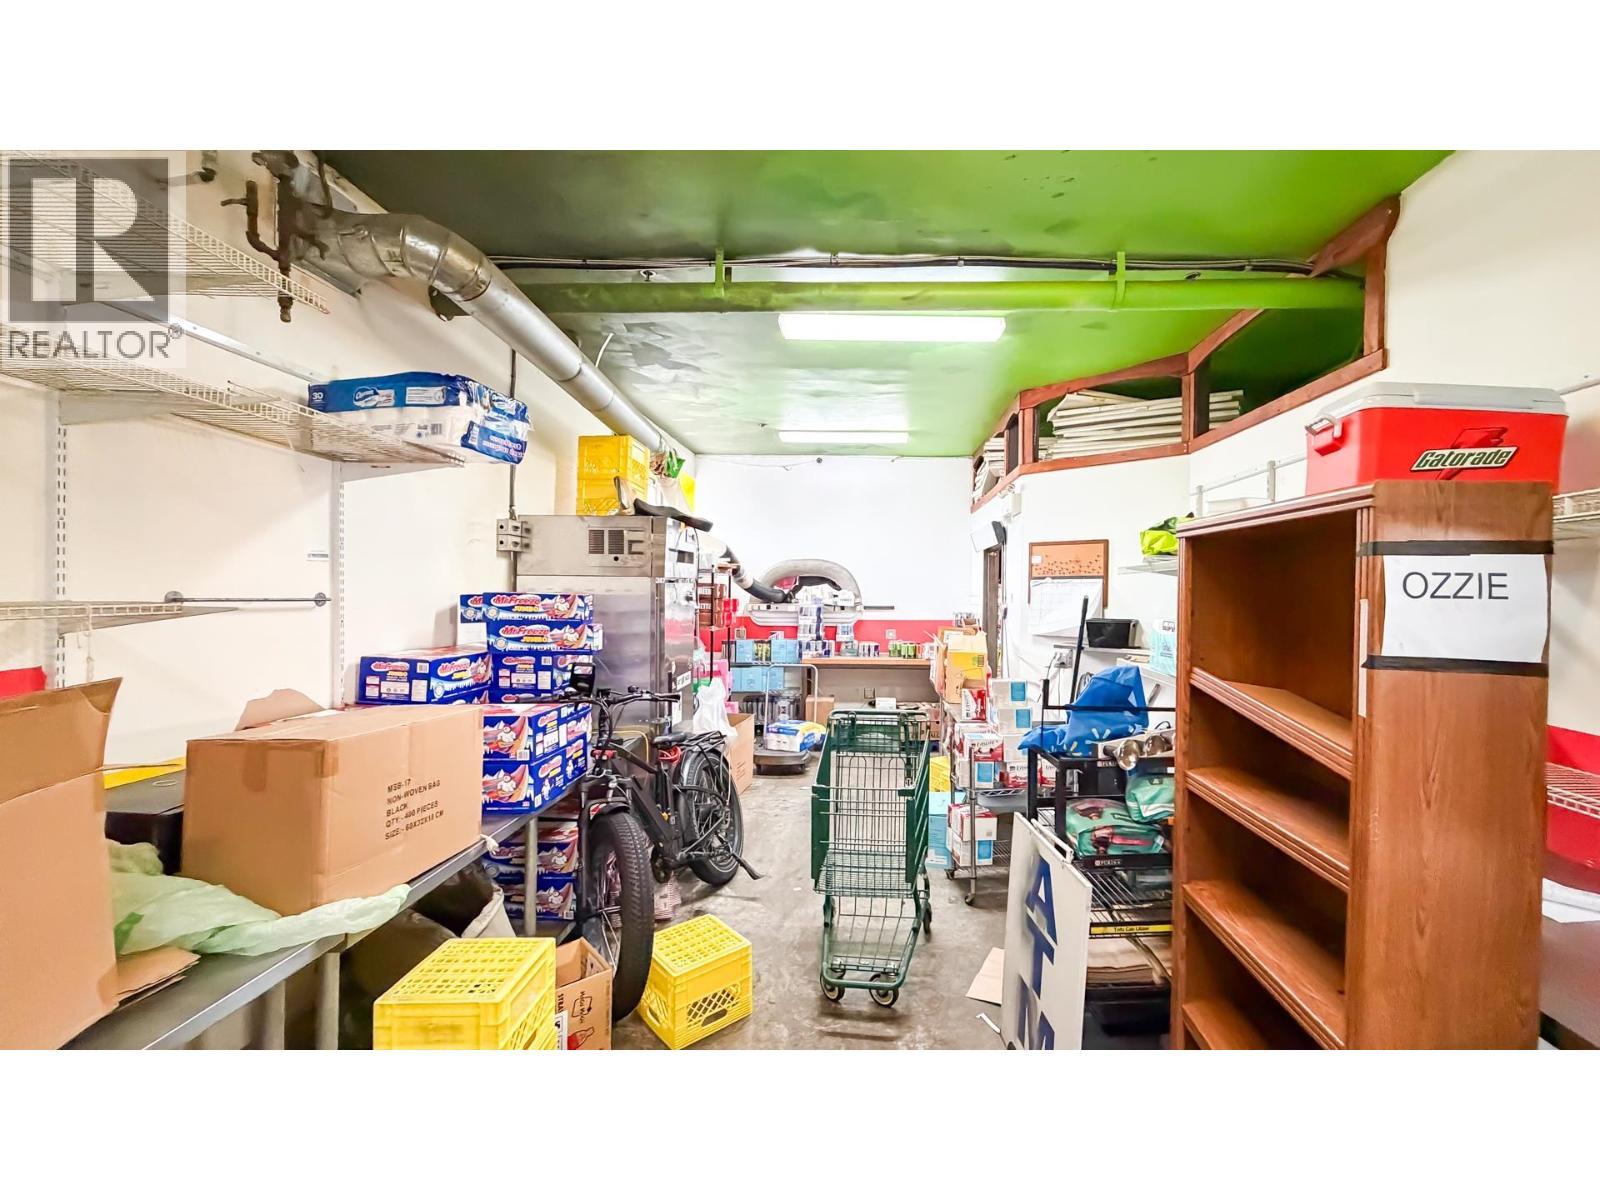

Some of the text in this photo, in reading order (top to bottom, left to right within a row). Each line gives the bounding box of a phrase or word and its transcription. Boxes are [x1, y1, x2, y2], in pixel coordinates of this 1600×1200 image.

[1415, 449, 1512, 468] Gatorade
[1402, 571, 1509, 600] OZZIE
[387, 779, 441, 804] NON-WOVEN BAG
[386, 803, 408, 817] BLACK
[416, 800, 439, 814] PIECES
[435, 810, 444, 819] CM
